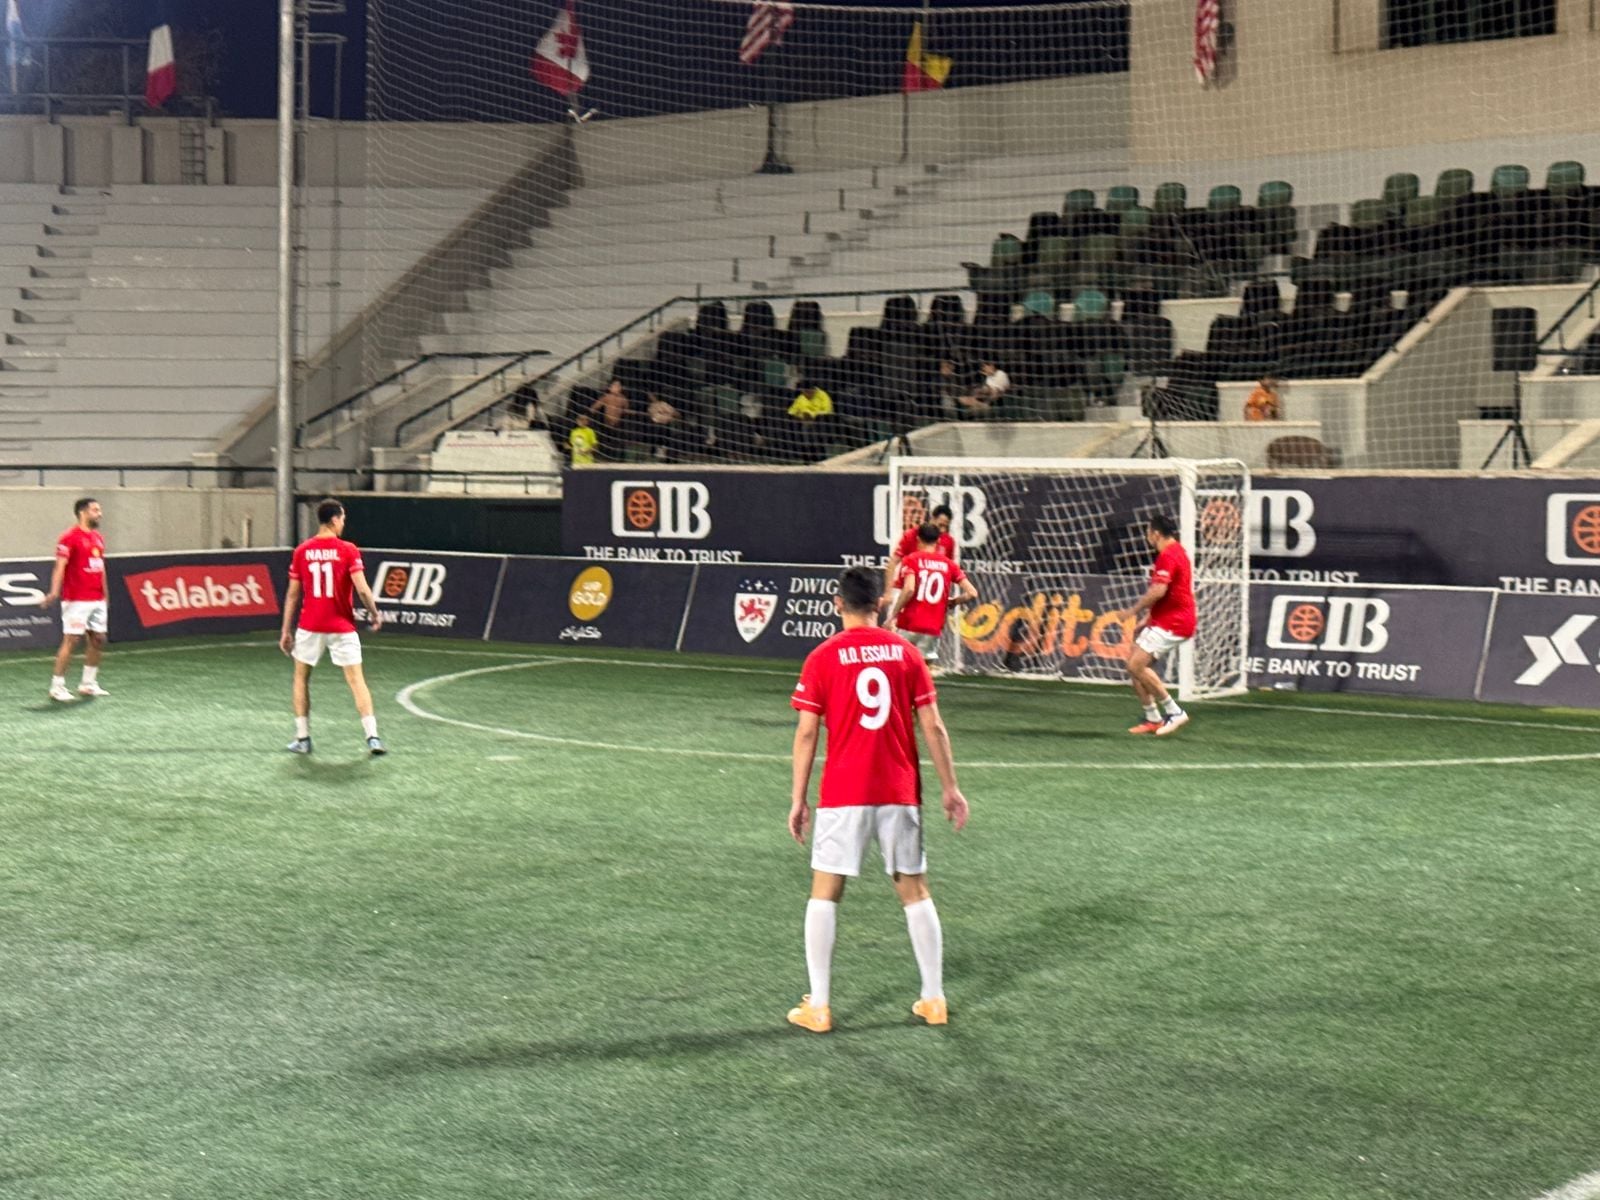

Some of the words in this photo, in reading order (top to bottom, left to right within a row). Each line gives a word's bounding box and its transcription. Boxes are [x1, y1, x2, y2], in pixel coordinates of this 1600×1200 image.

[611, 481, 712, 539] CIB
[305, 549, 340, 561] NABIL
[617, 548, 660, 561] BANK
[664, 549, 686, 562] TO
[689, 550, 742, 564] TRUST
[0, 573, 46, 606] S
[141, 575, 265, 612] talabat
[308, 562, 334, 598] 11
[372, 561, 447, 606] CIB
[917, 569, 944, 604] 10
[1499, 576, 1550, 594] THE
[401, 611, 417, 625] TO
[419, 612, 457, 627] TRUST
[781, 619, 836, 638] CAIRO
[1266, 594, 1390, 653] CIB
[860, 645, 904, 661] ESSALAY
[1267, 657, 1321, 676] BANK
[1324, 661, 1351, 677] TO
[1356, 662, 1421, 681] TRUST
[856, 666, 891, 730] 9
